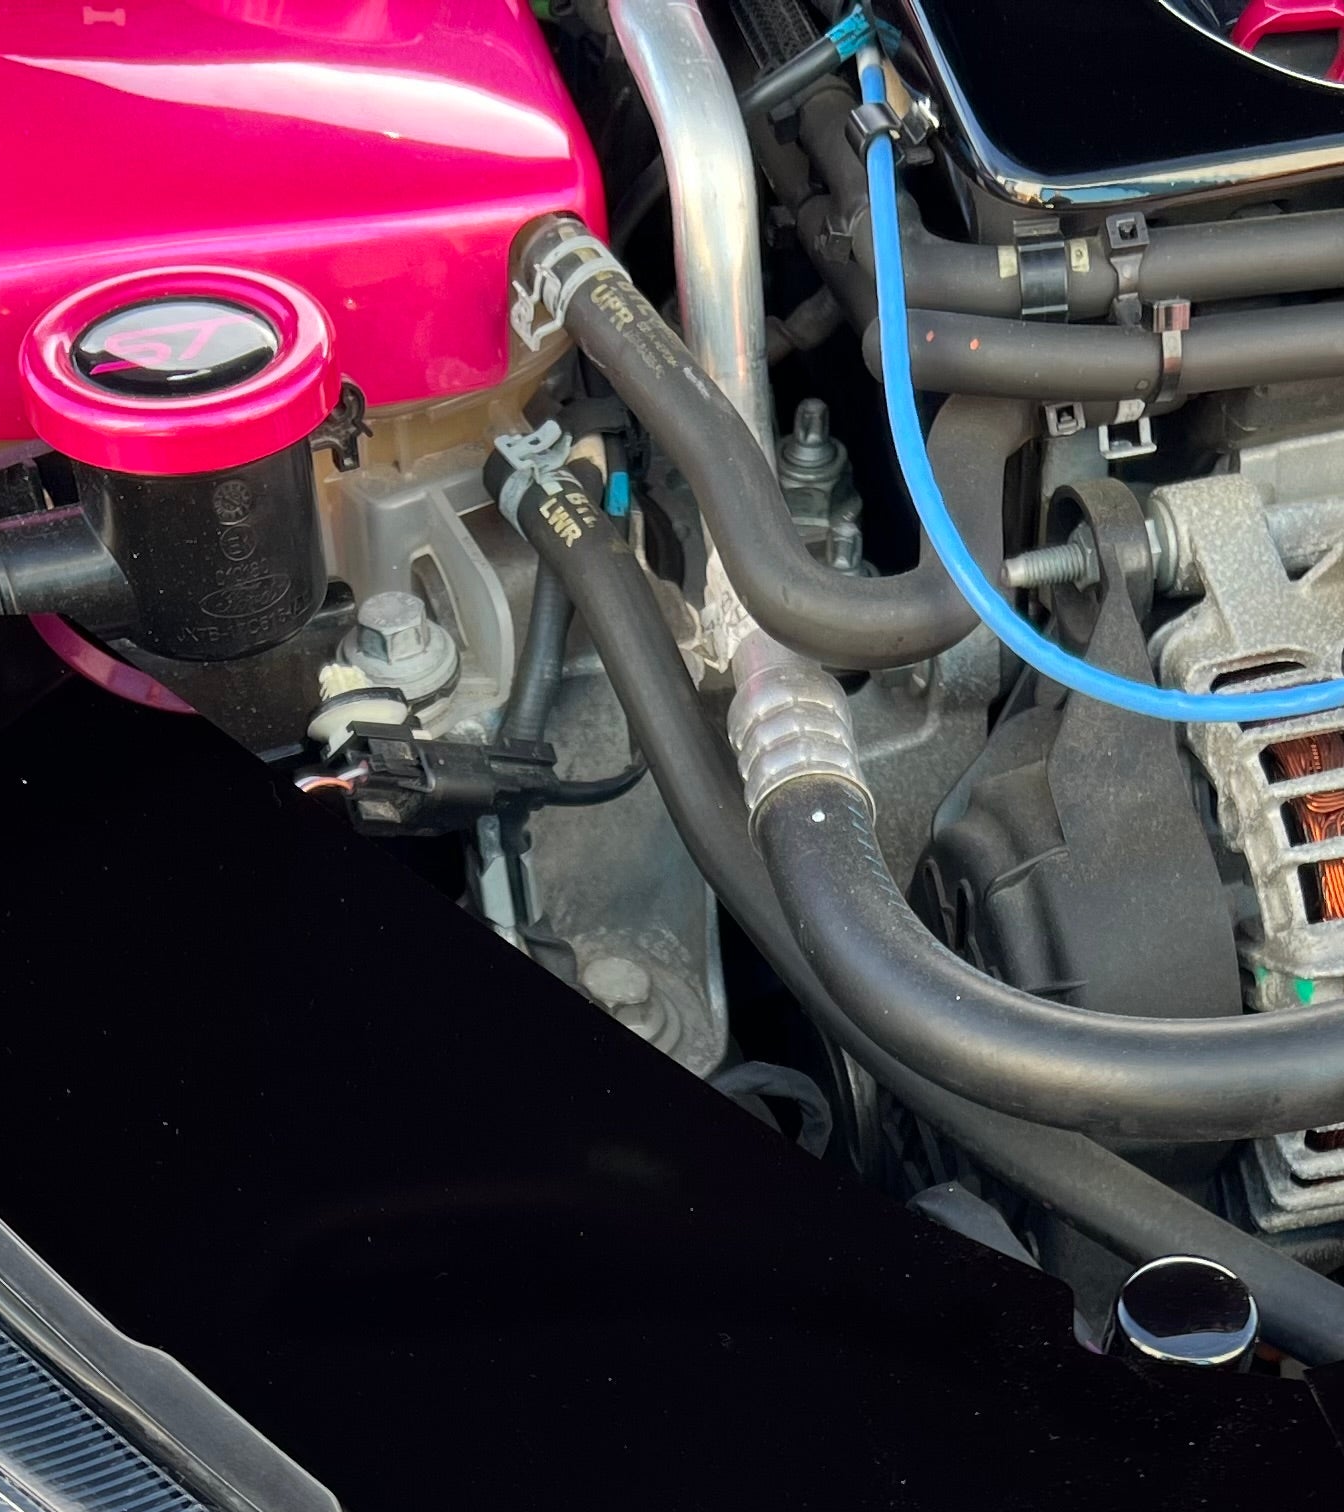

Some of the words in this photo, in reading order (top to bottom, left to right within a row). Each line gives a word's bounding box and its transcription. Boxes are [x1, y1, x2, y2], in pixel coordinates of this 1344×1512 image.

[591, 283, 635, 332] UPR
[89, 313, 255, 376] ST
[539, 497, 582, 548] LWR
